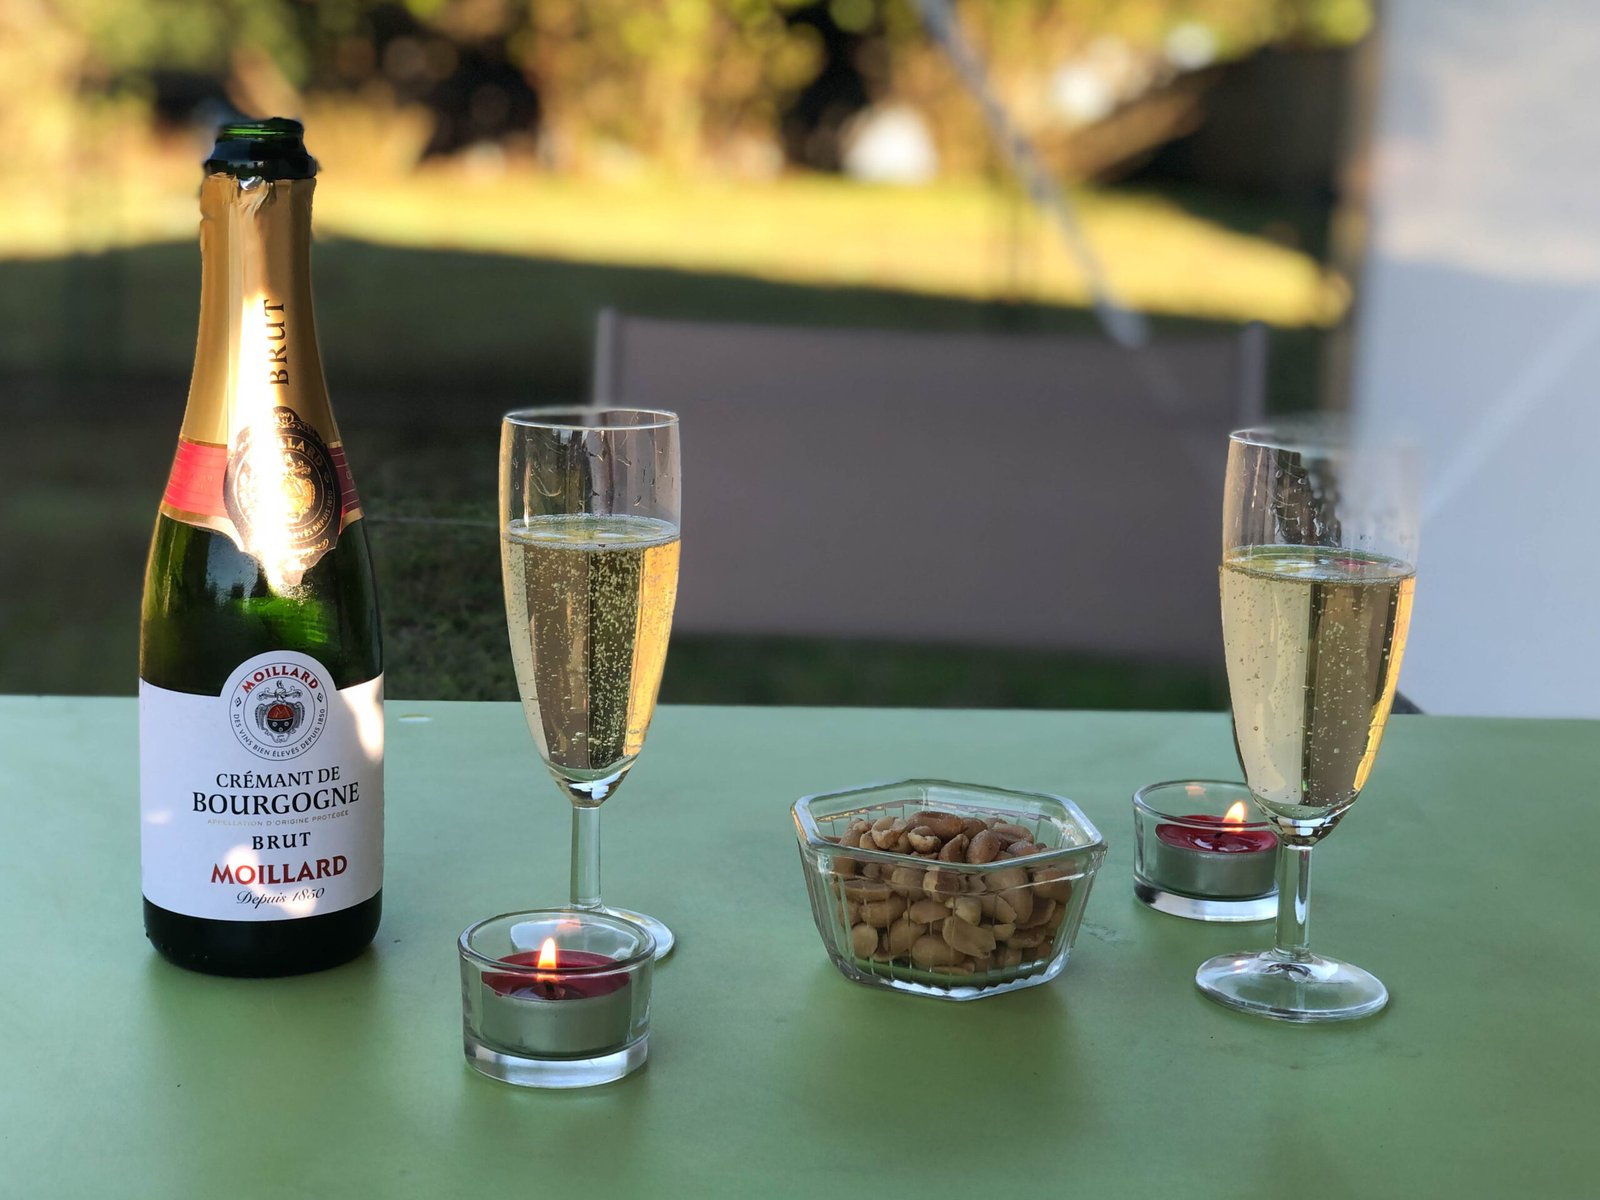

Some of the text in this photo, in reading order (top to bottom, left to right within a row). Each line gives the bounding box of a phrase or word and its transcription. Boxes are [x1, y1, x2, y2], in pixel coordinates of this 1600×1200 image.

[263, 299, 289, 386] BRUT
[241, 665, 319, 694] MOILLARD
[233, 713, 241, 728] DES
[239, 728, 253, 747] VINS
[252, 744, 271, 757] BIEN
[300, 726, 321, 750] DEPUIS
[216, 765, 341, 789] CRÉMANT DE
[192, 781, 361, 816] BOURGOGNE
[266, 816, 310, 827] D'ORIGINE
[252, 831, 312, 851] BRUT
[211, 855, 348, 886] MOILLARD
[236, 887, 326, 910] Depuis 1850
